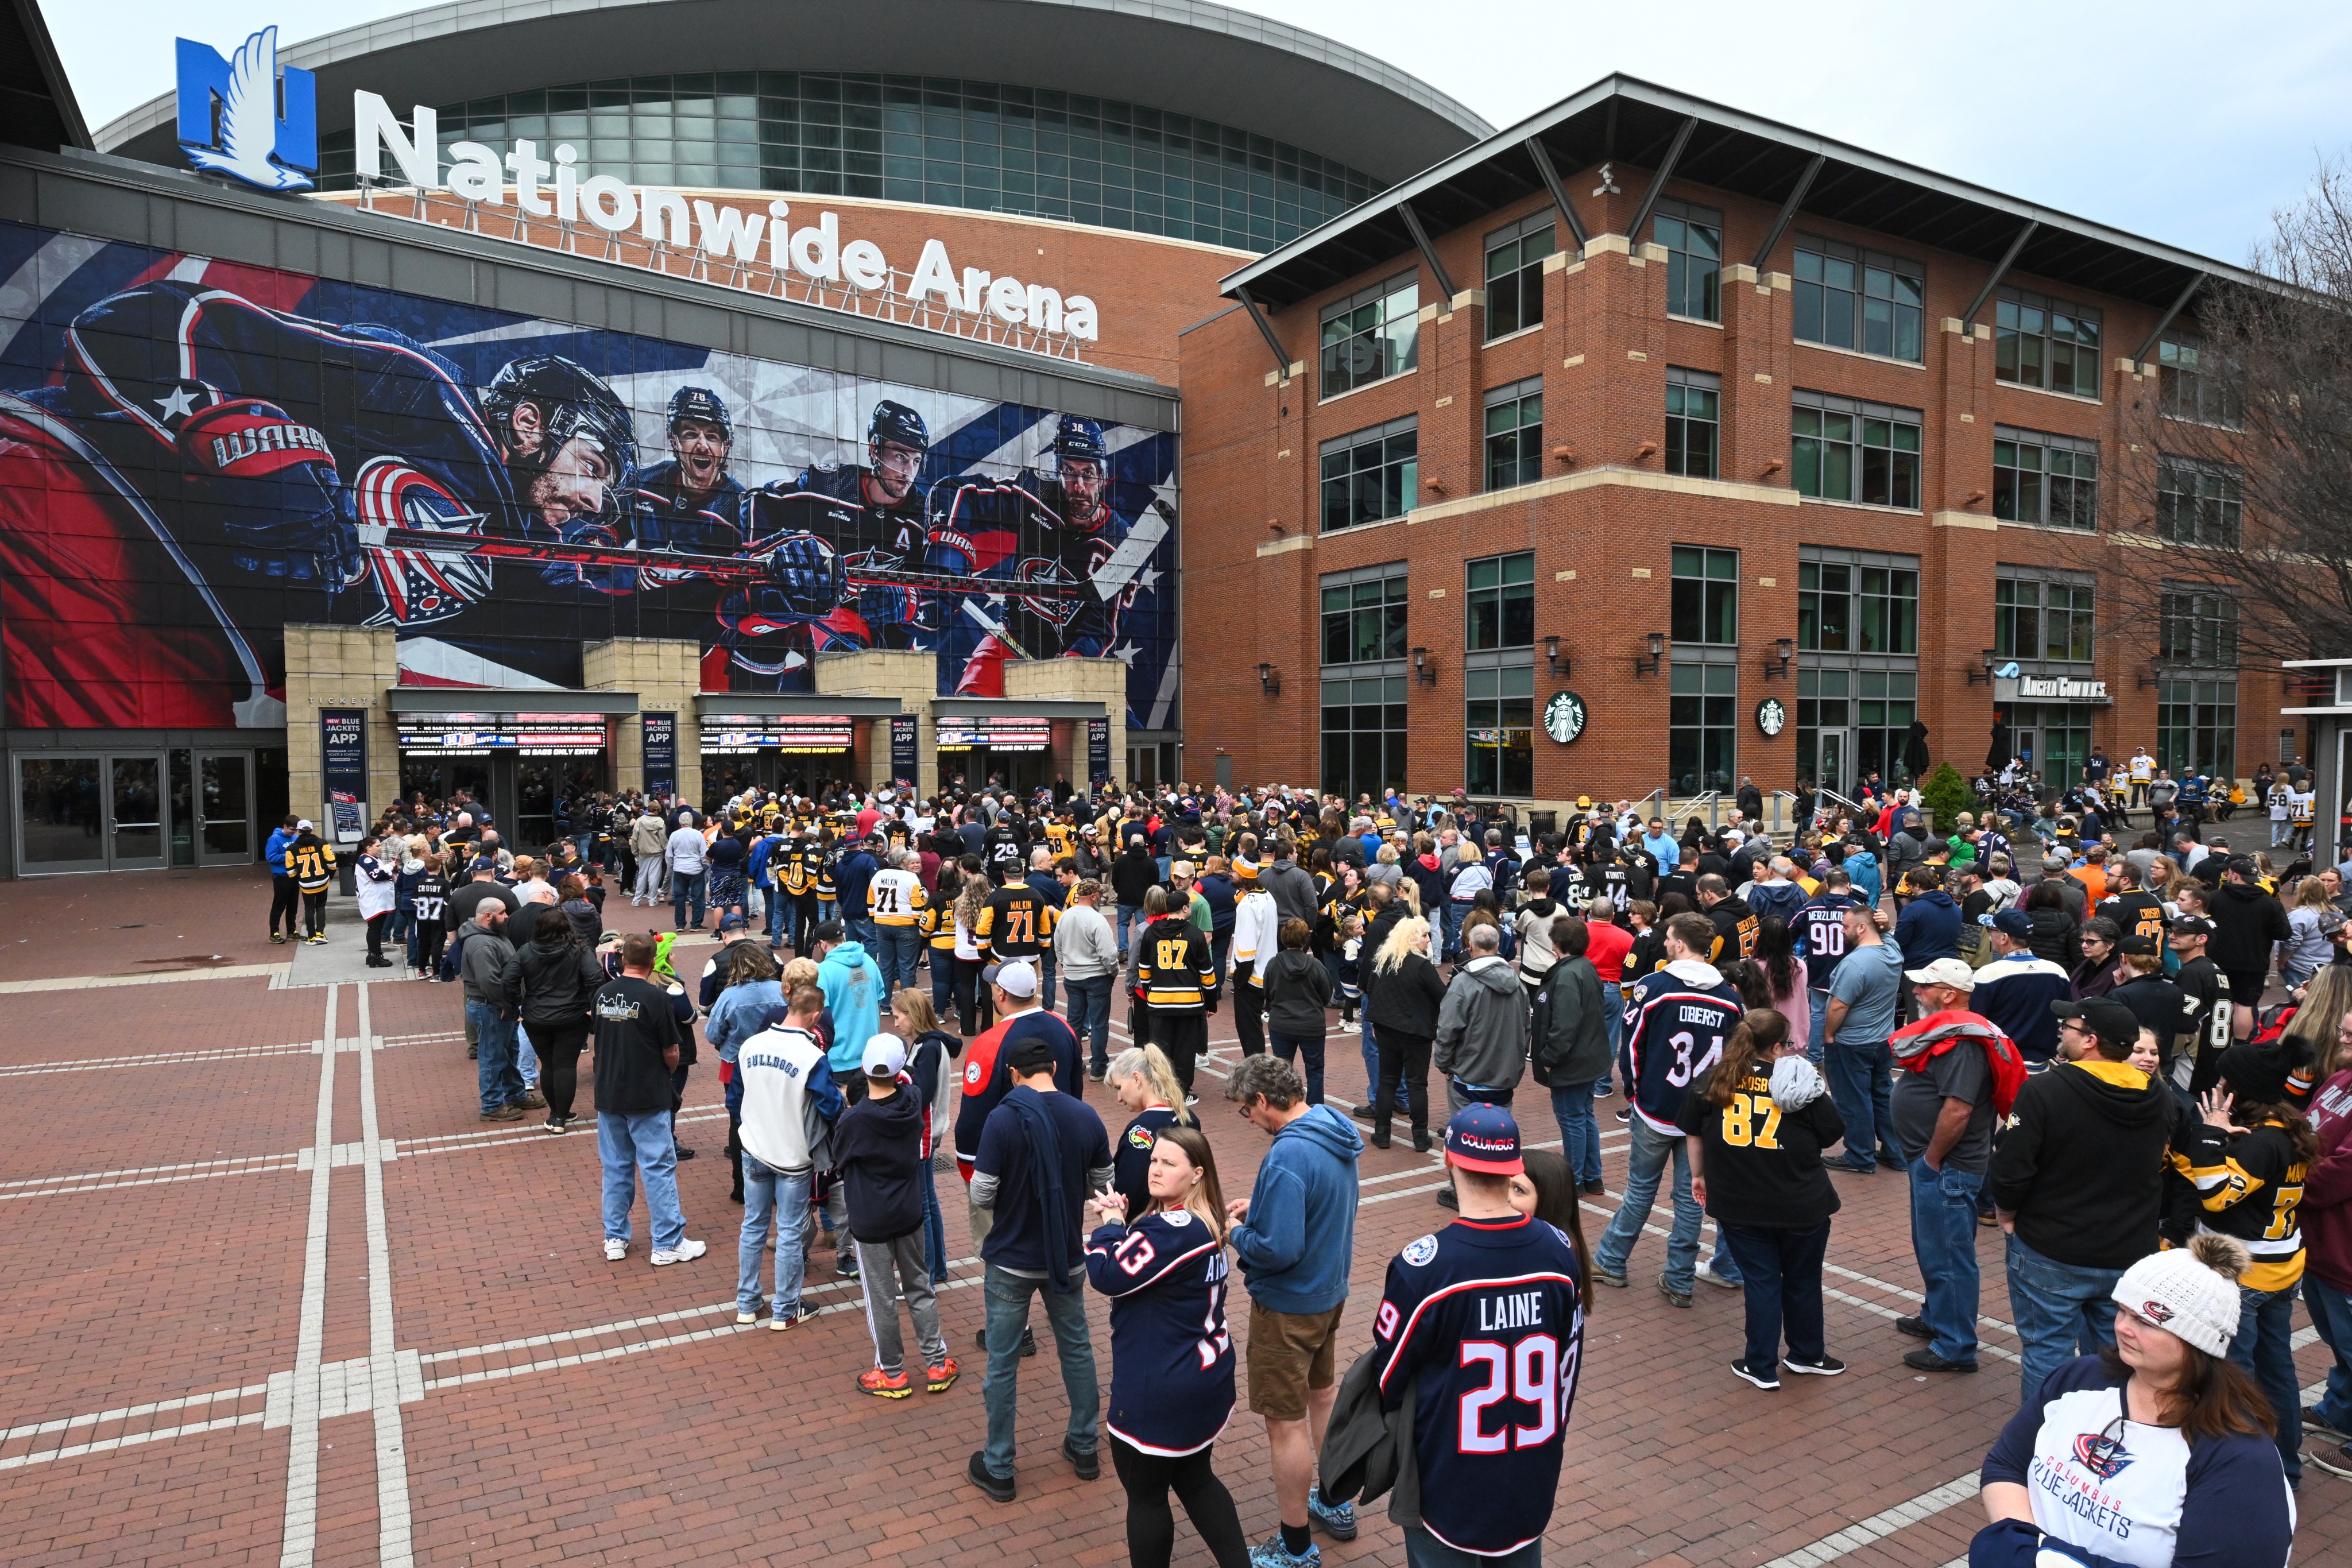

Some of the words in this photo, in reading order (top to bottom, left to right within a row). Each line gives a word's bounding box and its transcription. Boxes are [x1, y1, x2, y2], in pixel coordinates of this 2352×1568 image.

[354, 89, 887, 291] Nationwide
[906, 239, 1098, 342] Arena
[691, 392, 706, 401] 78
[1071, 423, 1084, 432] 38
[635, 503, 654, 512] Safelite
[828, 511, 850, 522] Safelite
[1030, 513, 1053, 531] Safelite
[895, 527, 911, 551] A
[2023, 676, 2057, 696] ANGELA
[2059, 677, 2081, 697] GUM
[2082, 681, 2107, 697] D.D.S.
[329, 734, 358, 744] APP
[447, 736, 457, 744] 50
[477, 735, 496, 743] RAFFLE
[648, 733, 670, 742] APP
[895, 734, 912, 742] APP
[2269, 794, 2288, 807] 58
[2291, 804, 2304, 817] 71
[831, 827, 840, 840] 7
[1579, 825, 1588, 842] 8
[299, 846, 315, 854] MALKIN
[995, 843, 1016, 861] 29
[1047, 838, 1062, 853] 58
[1979, 850, 1984, 858] 7
[296, 852, 325, 878] 71
[789, 862, 803, 886] 10
[881, 877, 898, 886] MALKIN
[1569, 873, 1584, 882] CROS
[1606, 871, 1626, 880] KUNITZ
[418, 884, 441, 893] CROSBY
[1566, 884, 1580, 909] 8
[1606, 883, 1626, 912] 14
[416, 897, 444, 920] 87
[876, 888, 898, 913] 71
[1010, 900, 1032, 911] MALKIN
[920, 915, 929, 926] 9
[942, 909, 956, 932] 2
[1808, 911, 1844, 922] MERZLIKI
[2140, 907, 2161, 919] CROSBY
[1007, 911, 1035, 943] 71
[1810, 923, 1844, 955] 90
[1156, 939, 1188, 970] 87
[1624, 951, 1638, 969] 8
[2183, 994, 2200, 1015] 7
[1679, 1005, 1725, 1028] OBERST
[2210, 998, 2233, 1048] 8
[746, 1054, 799, 1078] BULLDOGS
[1666, 1031, 1723, 1087] 34
[1735, 1075, 1770, 1093] CROSB
[2316, 1084, 2352, 1118] PUMA
[1723, 1093, 1782, 1149] 87
[1460, 1132, 1515, 1152] COLUMBUS
[1115, 1231, 1156, 1277] 13
[1480, 1291, 1543, 1331] LAINE
[1377, 1300, 1401, 1342] 9
[1458, 1333, 1558, 1454] 29
[2045, 1455, 2123, 1512] COLUMBUS
[2033, 1454, 2063, 1498] BLUE
[2062, 1486, 2134, 1540] JACKETS
